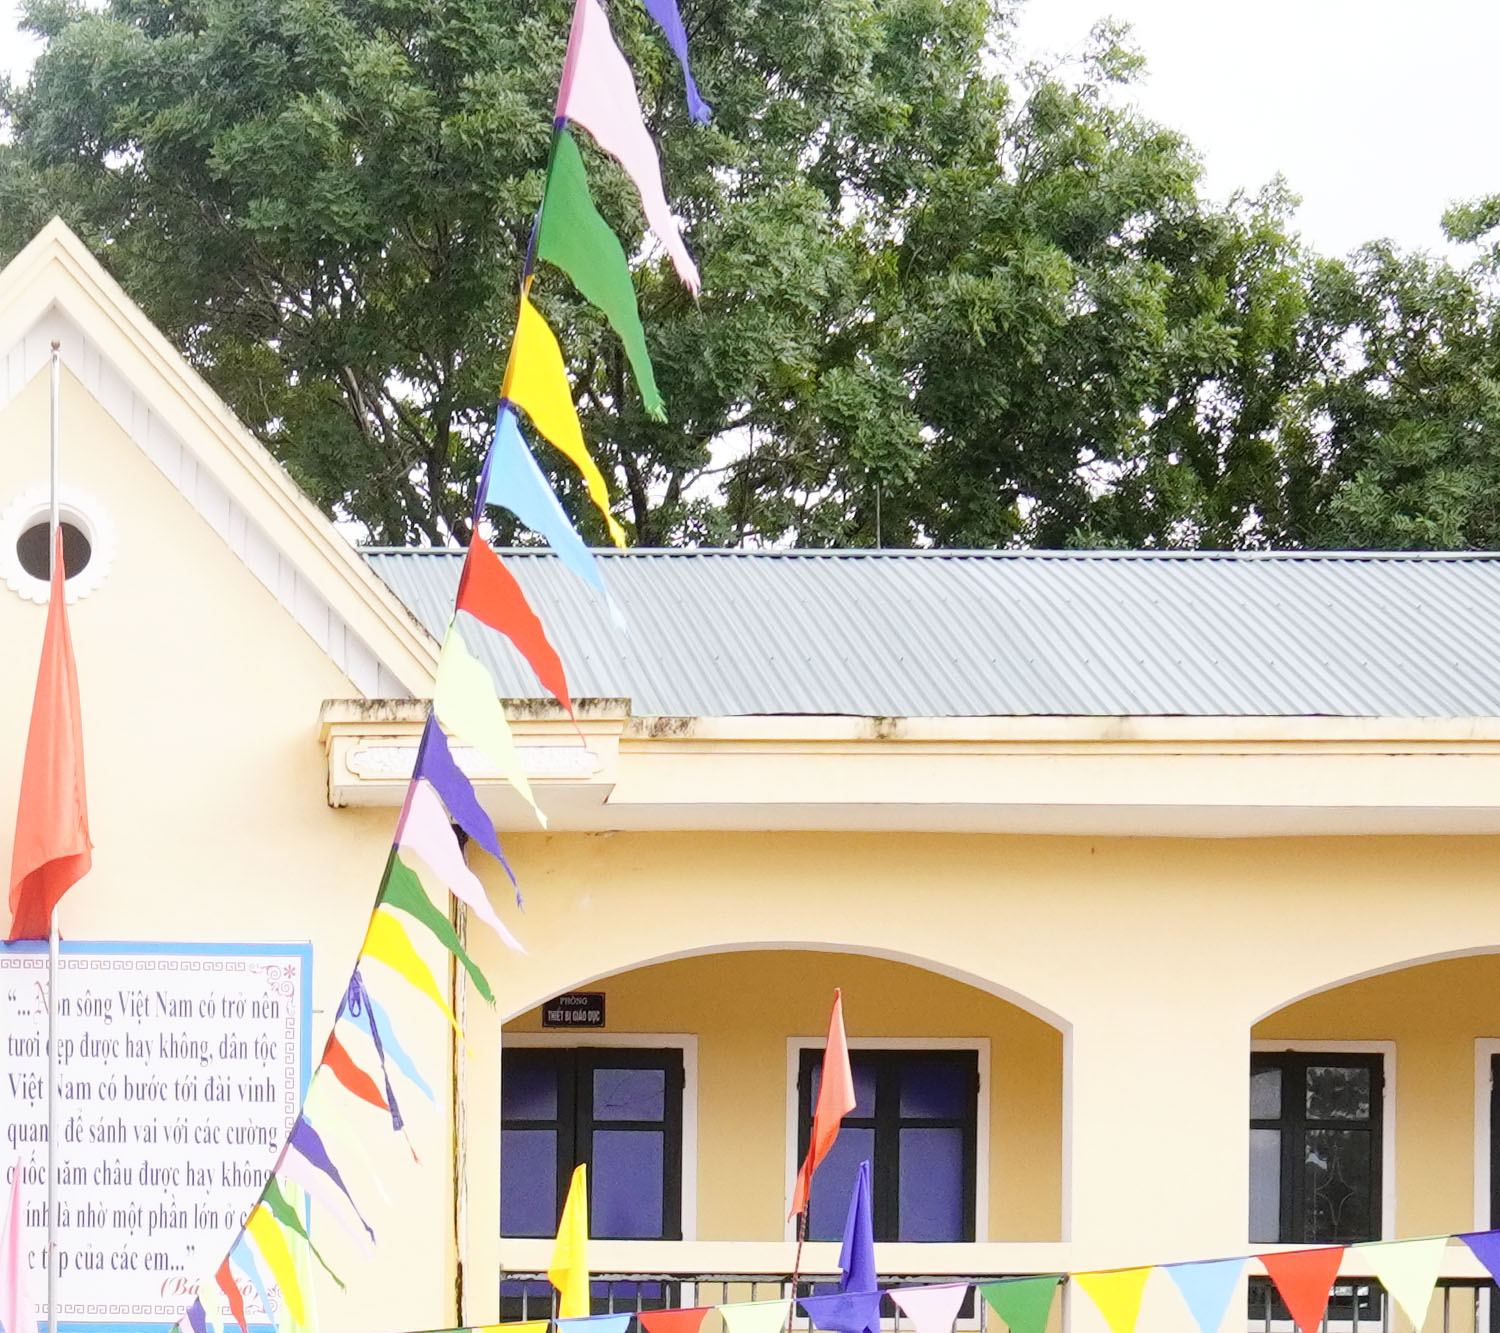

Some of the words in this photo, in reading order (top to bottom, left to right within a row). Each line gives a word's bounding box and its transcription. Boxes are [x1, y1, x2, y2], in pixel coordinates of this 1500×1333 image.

[77, 990, 112, 1025] sông
[119, 990, 150, 1024] Việt
[156, 991, 192, 1017] Nam
[199, 992, 216, 1018] có
[221, 992, 246, 1019] trở
[252, 992, 279, 1019] nên
[8, 1031, 40, 1057] tươi
[80, 1032, 119, 1065] được
[126, 1033, 152, 1066] hay
[159, 1032, 213, 1067] không,
[219, 1033, 248, 1059] dân
[254, 1033, 277, 1067] tộc
[8, 1072, 44, 1107] Việt
[98, 1074, 117, 1101] có
[124, 1074, 168, 1101] bước
[175, 1074, 197, 1101] tới
[204, 1075, 230, 1102] đài
[238, 1076, 276, 1102] vinh
[7, 1122, 58, 1150] quan
[89, 1117, 126, 1143] sánh
[133, 1117, 157, 1144] vai
[164, 1117, 188, 1144] với
[194, 1118, 219, 1145] các
[226, 1117, 277, 1154] cường
[94, 1158, 132, 1186] châu
[139, 1160, 180, 1194] được
[186, 1160, 213, 1195] hay
[57, 1201, 70, 1228] là
[77, 1201, 107, 1228] nhờ
[113, 1201, 143, 1236] một
[149, 1193, 187, 1236] phần
[194, 1202, 218, 1229] lớn
[75, 1243, 104, 1270] của
[111, 1243, 138, 1270] các
